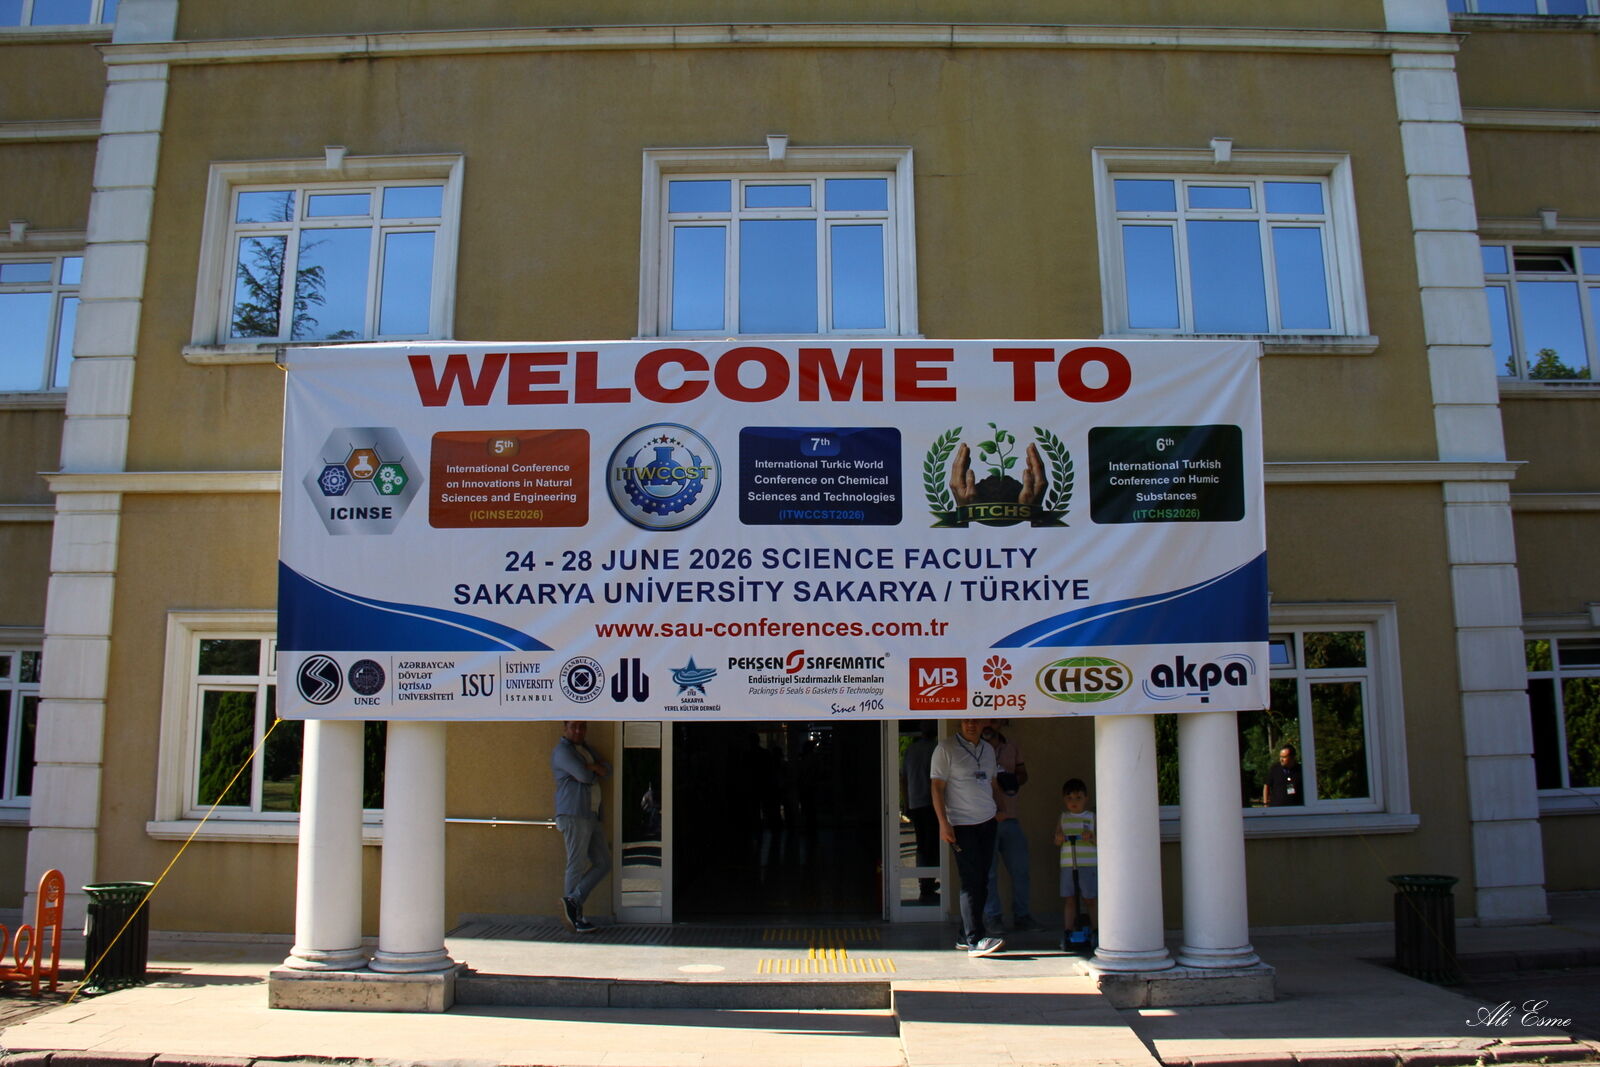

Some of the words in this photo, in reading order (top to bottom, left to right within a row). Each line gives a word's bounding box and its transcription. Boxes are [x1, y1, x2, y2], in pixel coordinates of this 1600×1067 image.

[407, 346, 957, 407] WELCOME
[993, 346, 1132, 403] TO
[494, 440, 514, 454] 5th
[810, 437, 831, 451] 7th
[1156, 438, 1175, 452] 6th
[446, 464, 509, 473] International
[512, 463, 570, 473] Conference
[755, 460, 818, 469] International
[821, 460, 852, 469] Turkic
[853, 460, 884, 470] World
[1108, 461, 1179, 471] International
[1182, 459, 1222, 469] Turkish
[616, 466, 713, 481] ITWCCST
[1109, 475, 1170, 486] Conference
[1172, 475, 1186, 484] on
[1188, 474, 1220, 484] Humic
[462, 479, 521, 488] Innovations
[523, 478, 533, 488] in
[535, 478, 573, 488] Natural
[754, 475, 818, 485] Conference
[820, 477, 835, 485] on
[837, 475, 889, 486] Chemical
[441, 493, 488, 503] Sciences
[491, 492, 511, 502] and
[513, 492, 577, 503] Engineering
[747, 491, 797, 502] Sciences
[800, 492, 821, 502] and
[823, 492, 896, 504] Technologies
[1136, 491, 1197, 502] Substances
[330, 507, 393, 520] ICINSE
[469, 510, 544, 522] (ICINSE2026)
[778, 509, 865, 521] (ITWCCST2026)
[967, 505, 1032, 518] ITCHS
[1132, 508, 1201, 521] (ITCHS2026)
[505, 550, 536, 572] 24
[561, 550, 593, 571] 28
[601, 549, 679, 571] JUNE
[689, 548, 752, 570] 2026
[761, 548, 894, 569] SCIENCE
[904, 547, 1038, 569] FACULTY
[453, 583, 595, 605] SAKARYA
[604, 576, 785, 603] UNİVERSİTY
[793, 581, 937, 602] SAKARYA
[943, 581, 952, 602] /
[960, 575, 1090, 601] TÜRKİYE
[595, 617, 949, 637] www.sau-conferences.com.tr
[506, 661, 541, 674] İSTİNYE
[728, 657, 784, 671] PEKŞEN
[807, 656, 885, 669] SAFEMATIC
[748, 675, 793, 686] Endüstriyel
[794, 675, 842, 684] Sızdırmazlık
[843, 675, 884, 684] Elemanları
[918, 668, 959, 687] MB
[1150, 655, 1248, 703] akpa
[461, 674, 495, 697] ISU
[506, 679, 554, 690] UNIVERSITY
[749, 687, 778, 696] Packings
[786, 687, 804, 695] Seals
[812, 687, 838, 695] Gaskets
[846, 687, 884, 696] Technology
[354, 697, 380, 706] UNEC
[831, 703, 856, 715] Since
[859, 699, 884, 712] 1906
[972, 691, 1027, 711] özpaş
